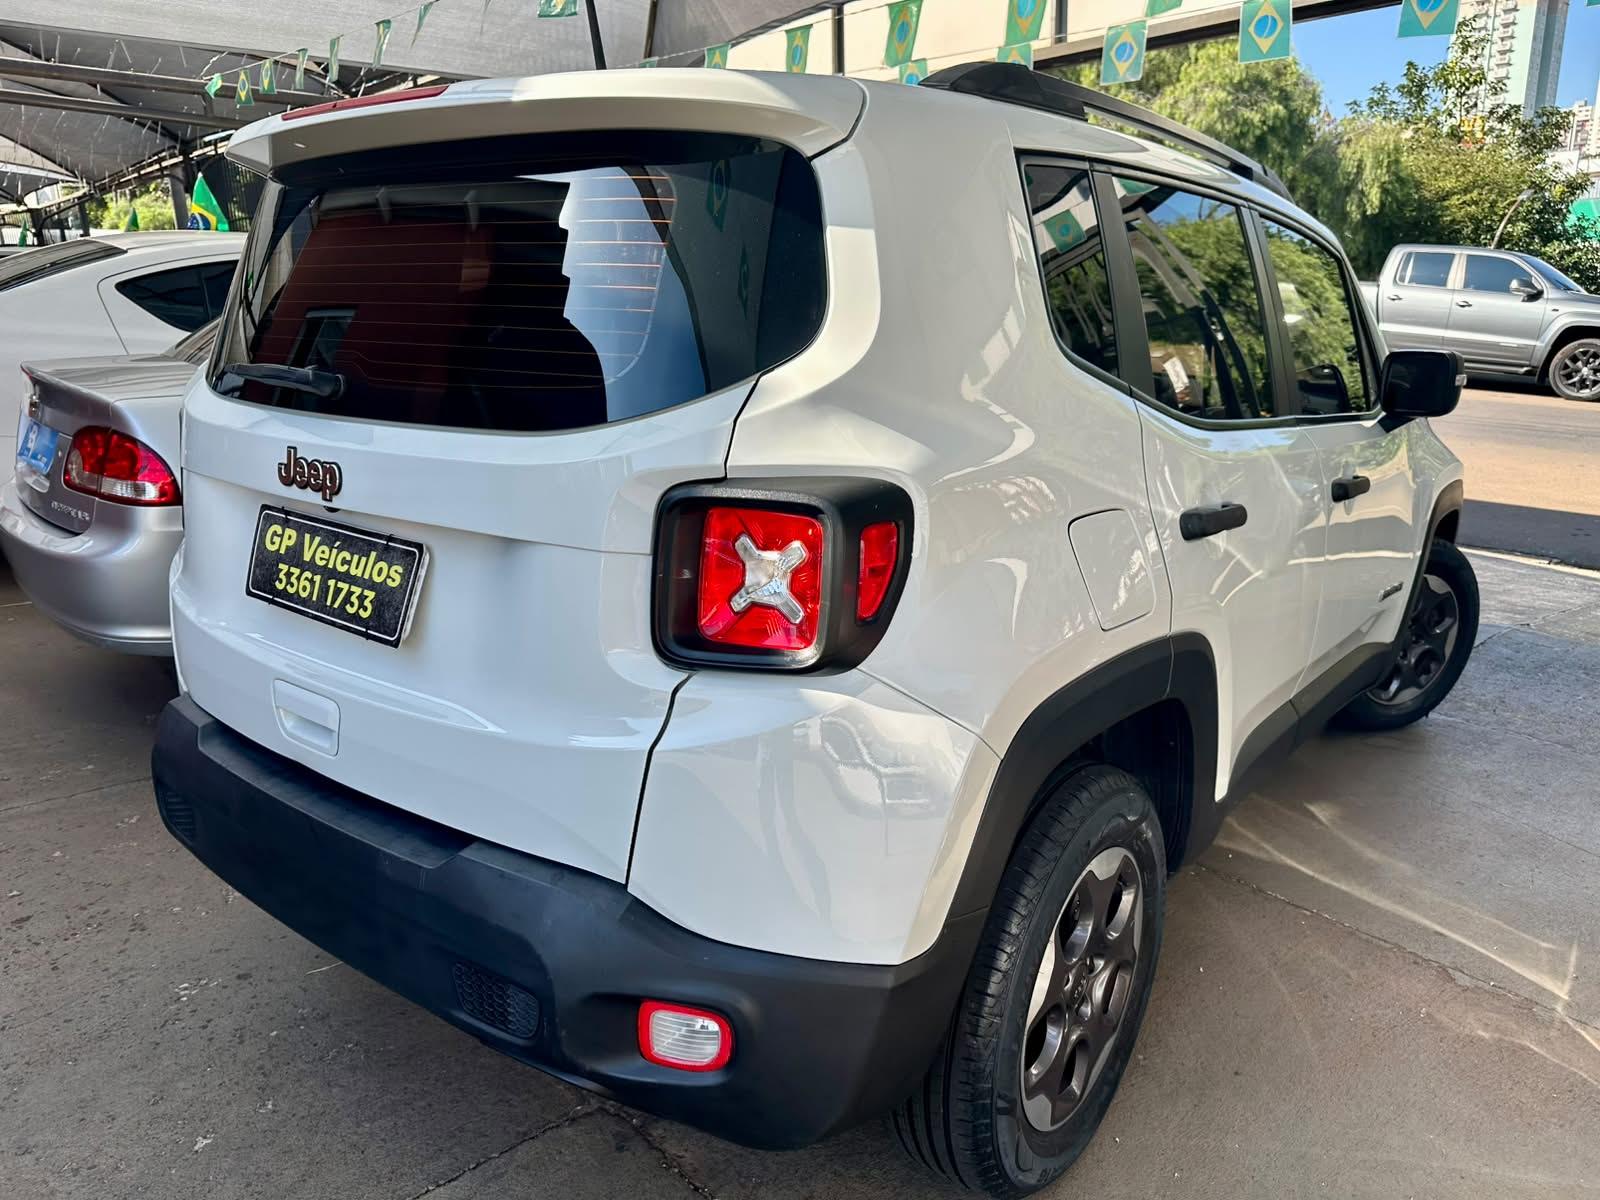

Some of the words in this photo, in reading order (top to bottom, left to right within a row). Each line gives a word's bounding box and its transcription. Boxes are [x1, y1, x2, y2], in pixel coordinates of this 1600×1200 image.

[278, 446, 342, 502] Jeep
[264, 524, 297, 555] GP
[302, 533, 403, 588] Veículos
[275, 563, 321, 601] 3361
[326, 579, 376, 619] 1733
